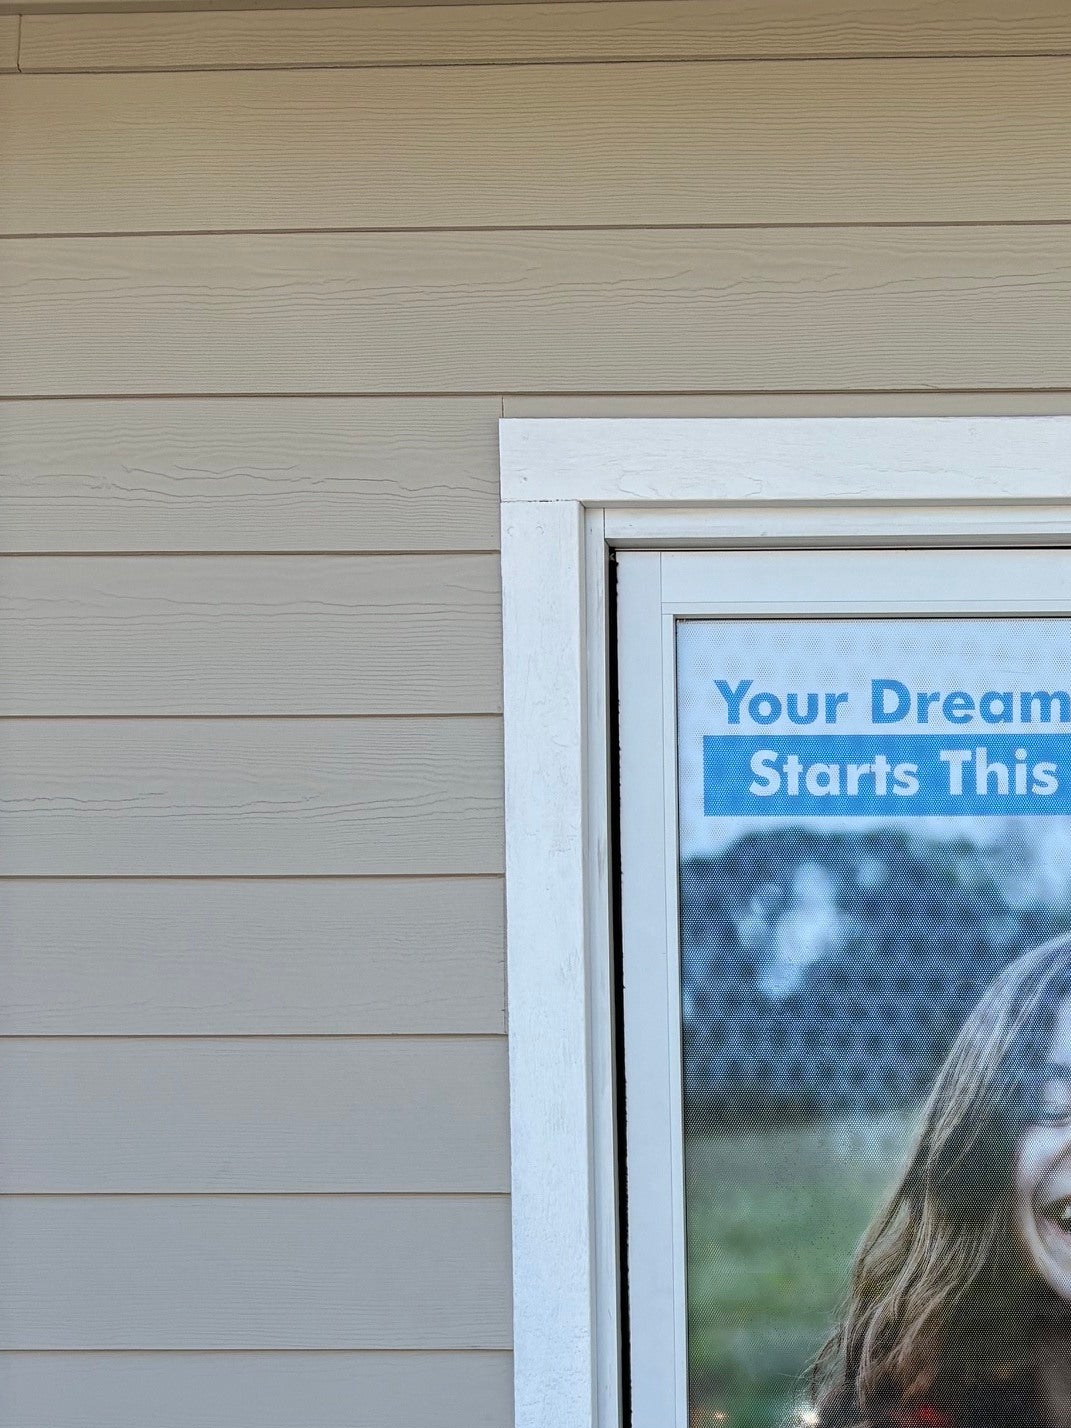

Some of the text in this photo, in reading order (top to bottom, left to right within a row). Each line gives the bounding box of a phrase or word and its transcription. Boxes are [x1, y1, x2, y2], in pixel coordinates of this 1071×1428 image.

[714, 678, 848, 725] Your
[872, 678, 1071, 725] Dream
[749, 749, 920, 798] Starts
[940, 747, 1059, 796] This
